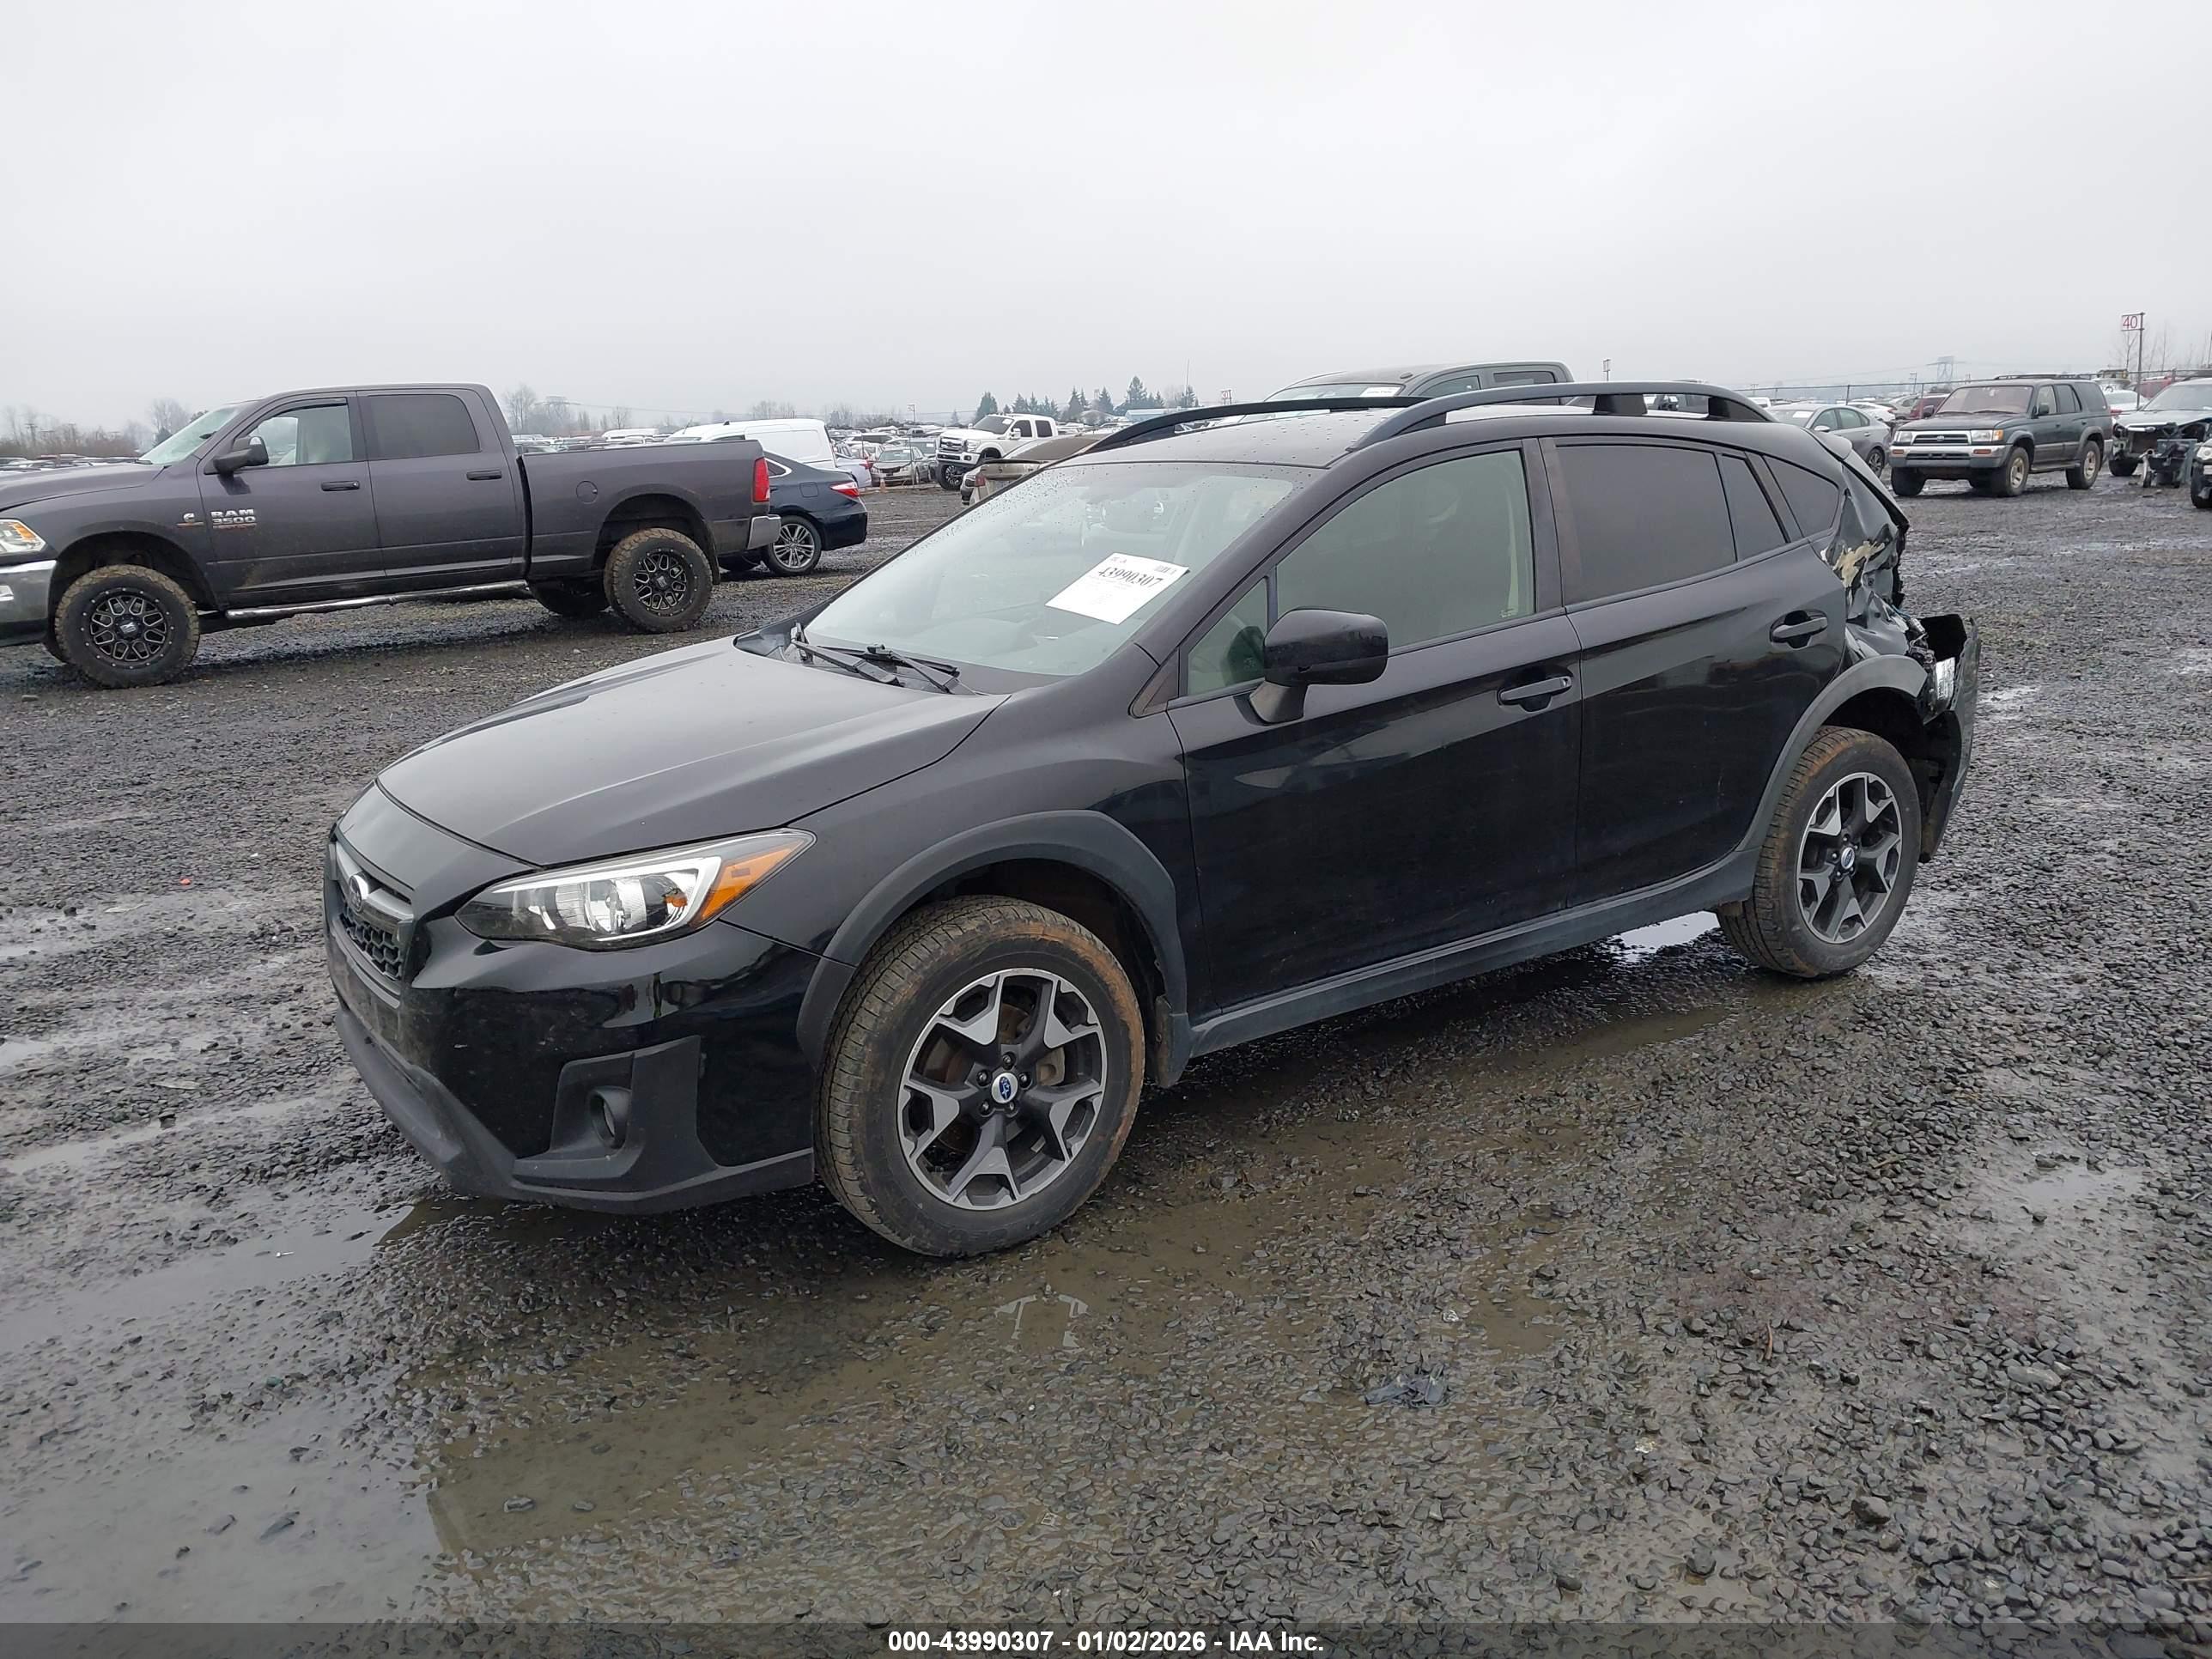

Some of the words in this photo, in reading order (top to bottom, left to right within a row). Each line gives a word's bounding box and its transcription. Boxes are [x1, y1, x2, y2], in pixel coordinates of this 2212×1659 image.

[2123, 315, 2138, 329] 40
[210, 508, 254, 518] RAM
[212, 516, 256, 525] 3500
[1098, 568, 1164, 587] 43990307
